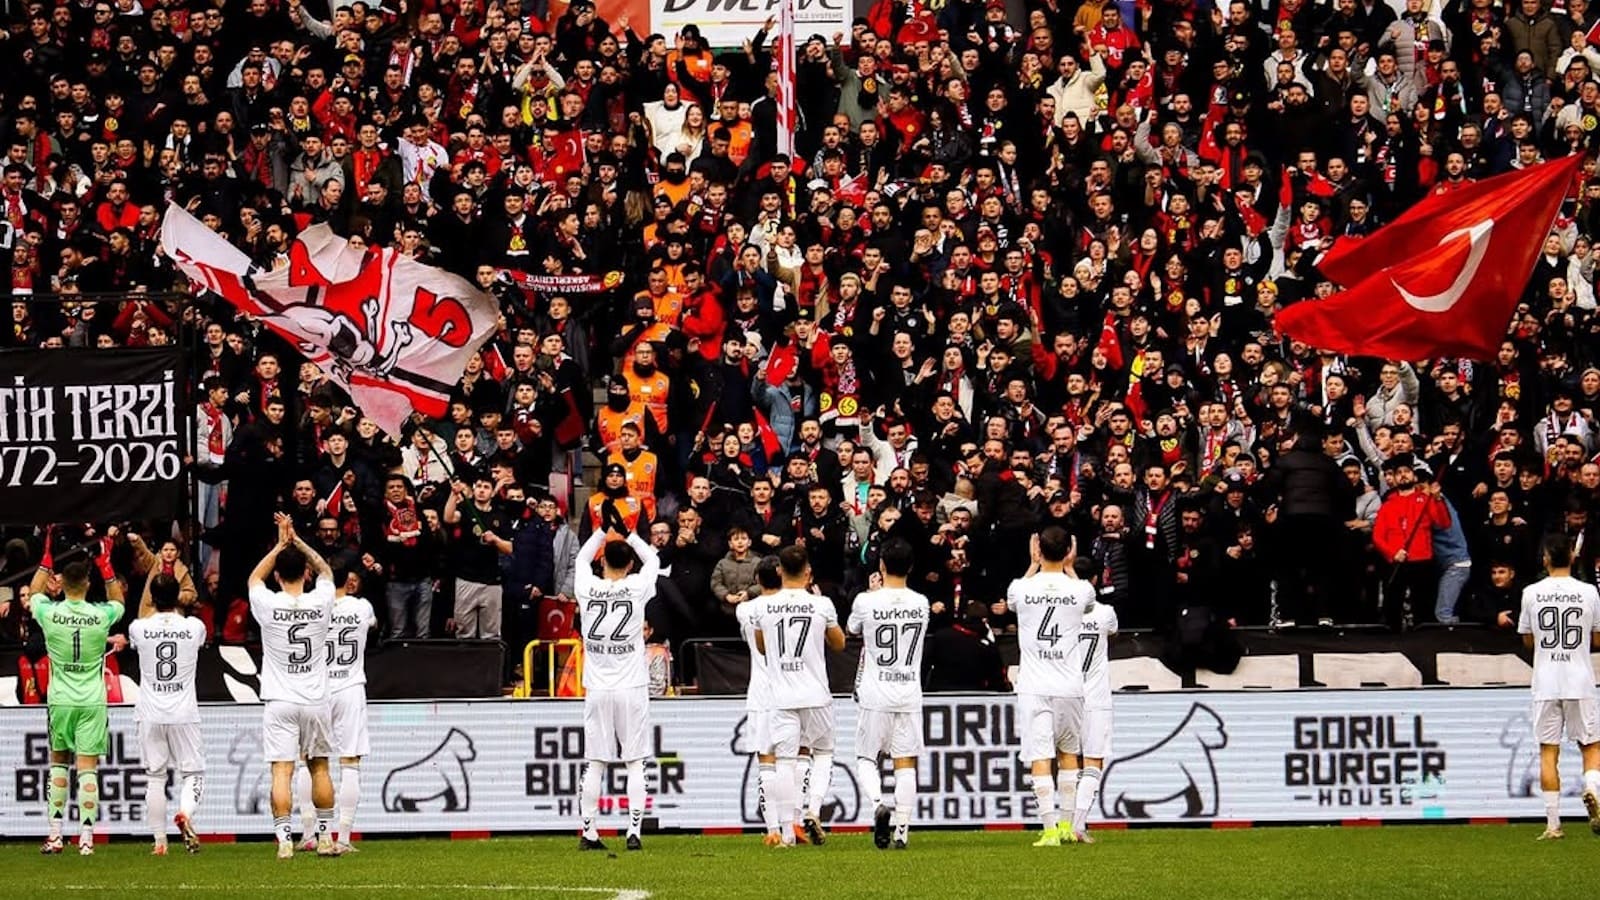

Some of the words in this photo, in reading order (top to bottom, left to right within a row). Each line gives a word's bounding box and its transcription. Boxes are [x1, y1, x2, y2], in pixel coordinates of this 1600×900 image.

[1024, 594, 1078, 606] turknet
[1536, 592, 1584, 603] turknet
[272, 608, 325, 621] turknet
[766, 603, 815, 614] turknet
[873, 608, 924, 621] turknet
[52, 613, 101, 626] turknet
[331, 613, 361, 624] knet
[586, 600, 633, 641] 22
[143, 629, 193, 640] turknet
[1036, 606, 1063, 648] 4
[1537, 606, 1583, 650] 96
[70, 626, 81, 664] 1
[287, 622, 313, 664] 5
[774, 616, 813, 659] 17
[875, 622, 924, 668] 97
[155, 641, 178, 681] 8
[1037, 650, 1064, 660] TALHA
[287, 664, 312, 674] OZAN
[152, 682, 184, 693] TAYFUN
[1294, 714, 1439, 749] GORILL
[535, 725, 678, 760] GOL
[1318, 788, 1413, 806] HOUSE
